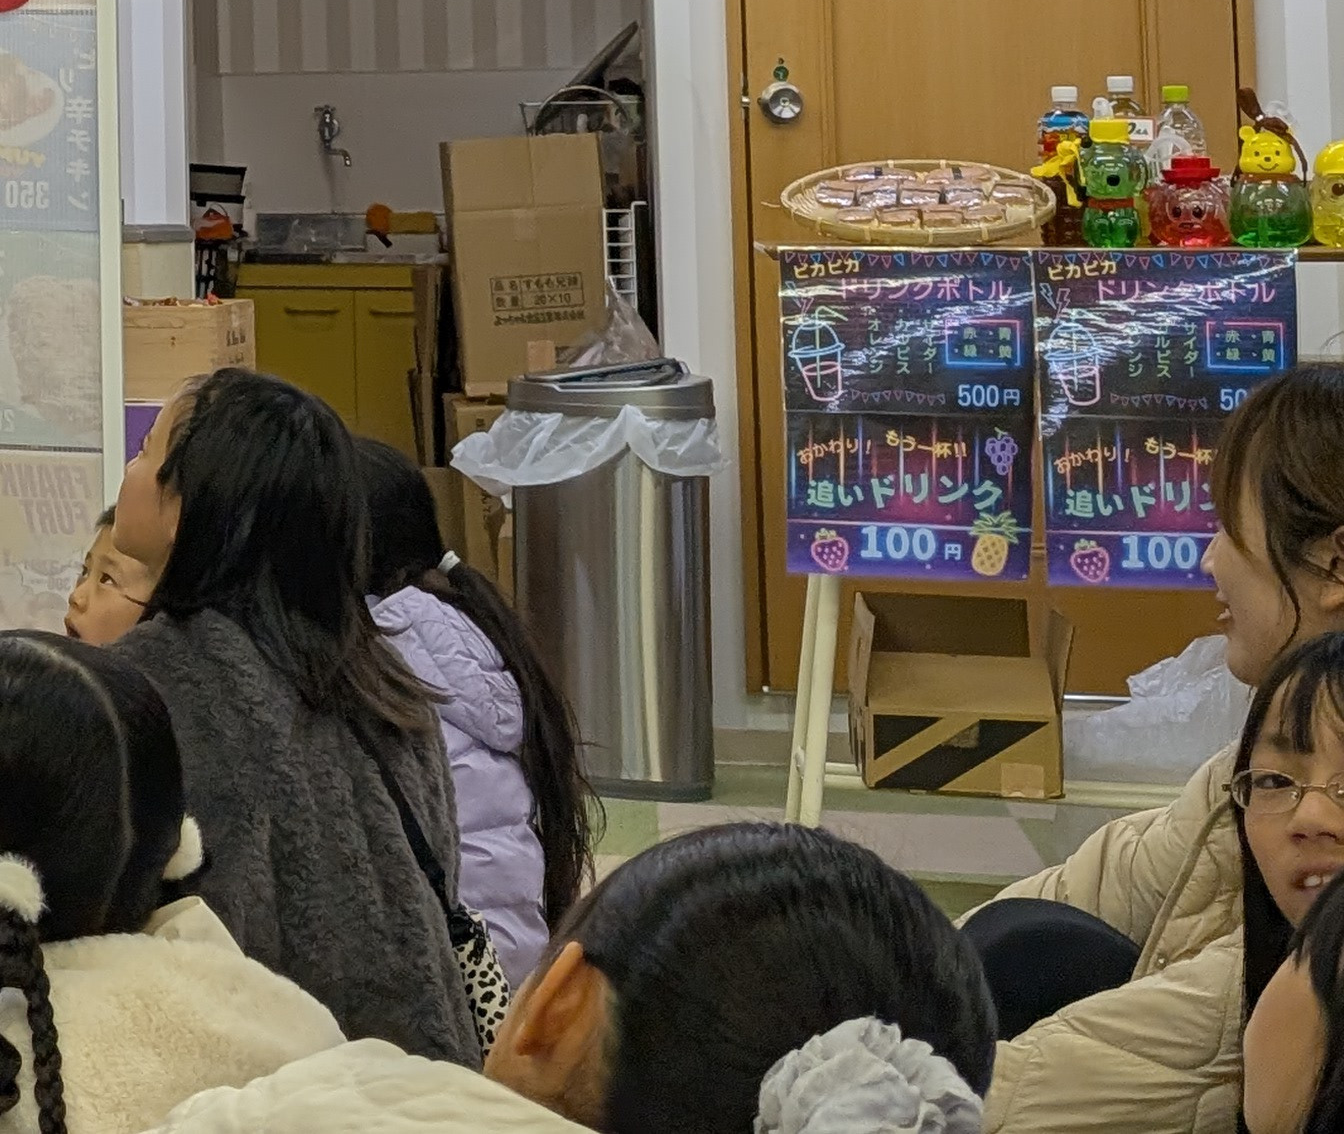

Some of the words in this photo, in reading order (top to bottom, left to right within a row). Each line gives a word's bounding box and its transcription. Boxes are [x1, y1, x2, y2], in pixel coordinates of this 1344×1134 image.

[793, 258, 861, 279] ピカピカ
[1048, 260, 1117, 281] ピカピカ
[838, 278, 1014, 302] ドリンクボトル
[957, 384, 1020, 408] 500円
[807, 472, 1003, 509] 追いドリンク
[860, 525, 962, 561] 100円
[1120, 535, 1199, 569] 100
